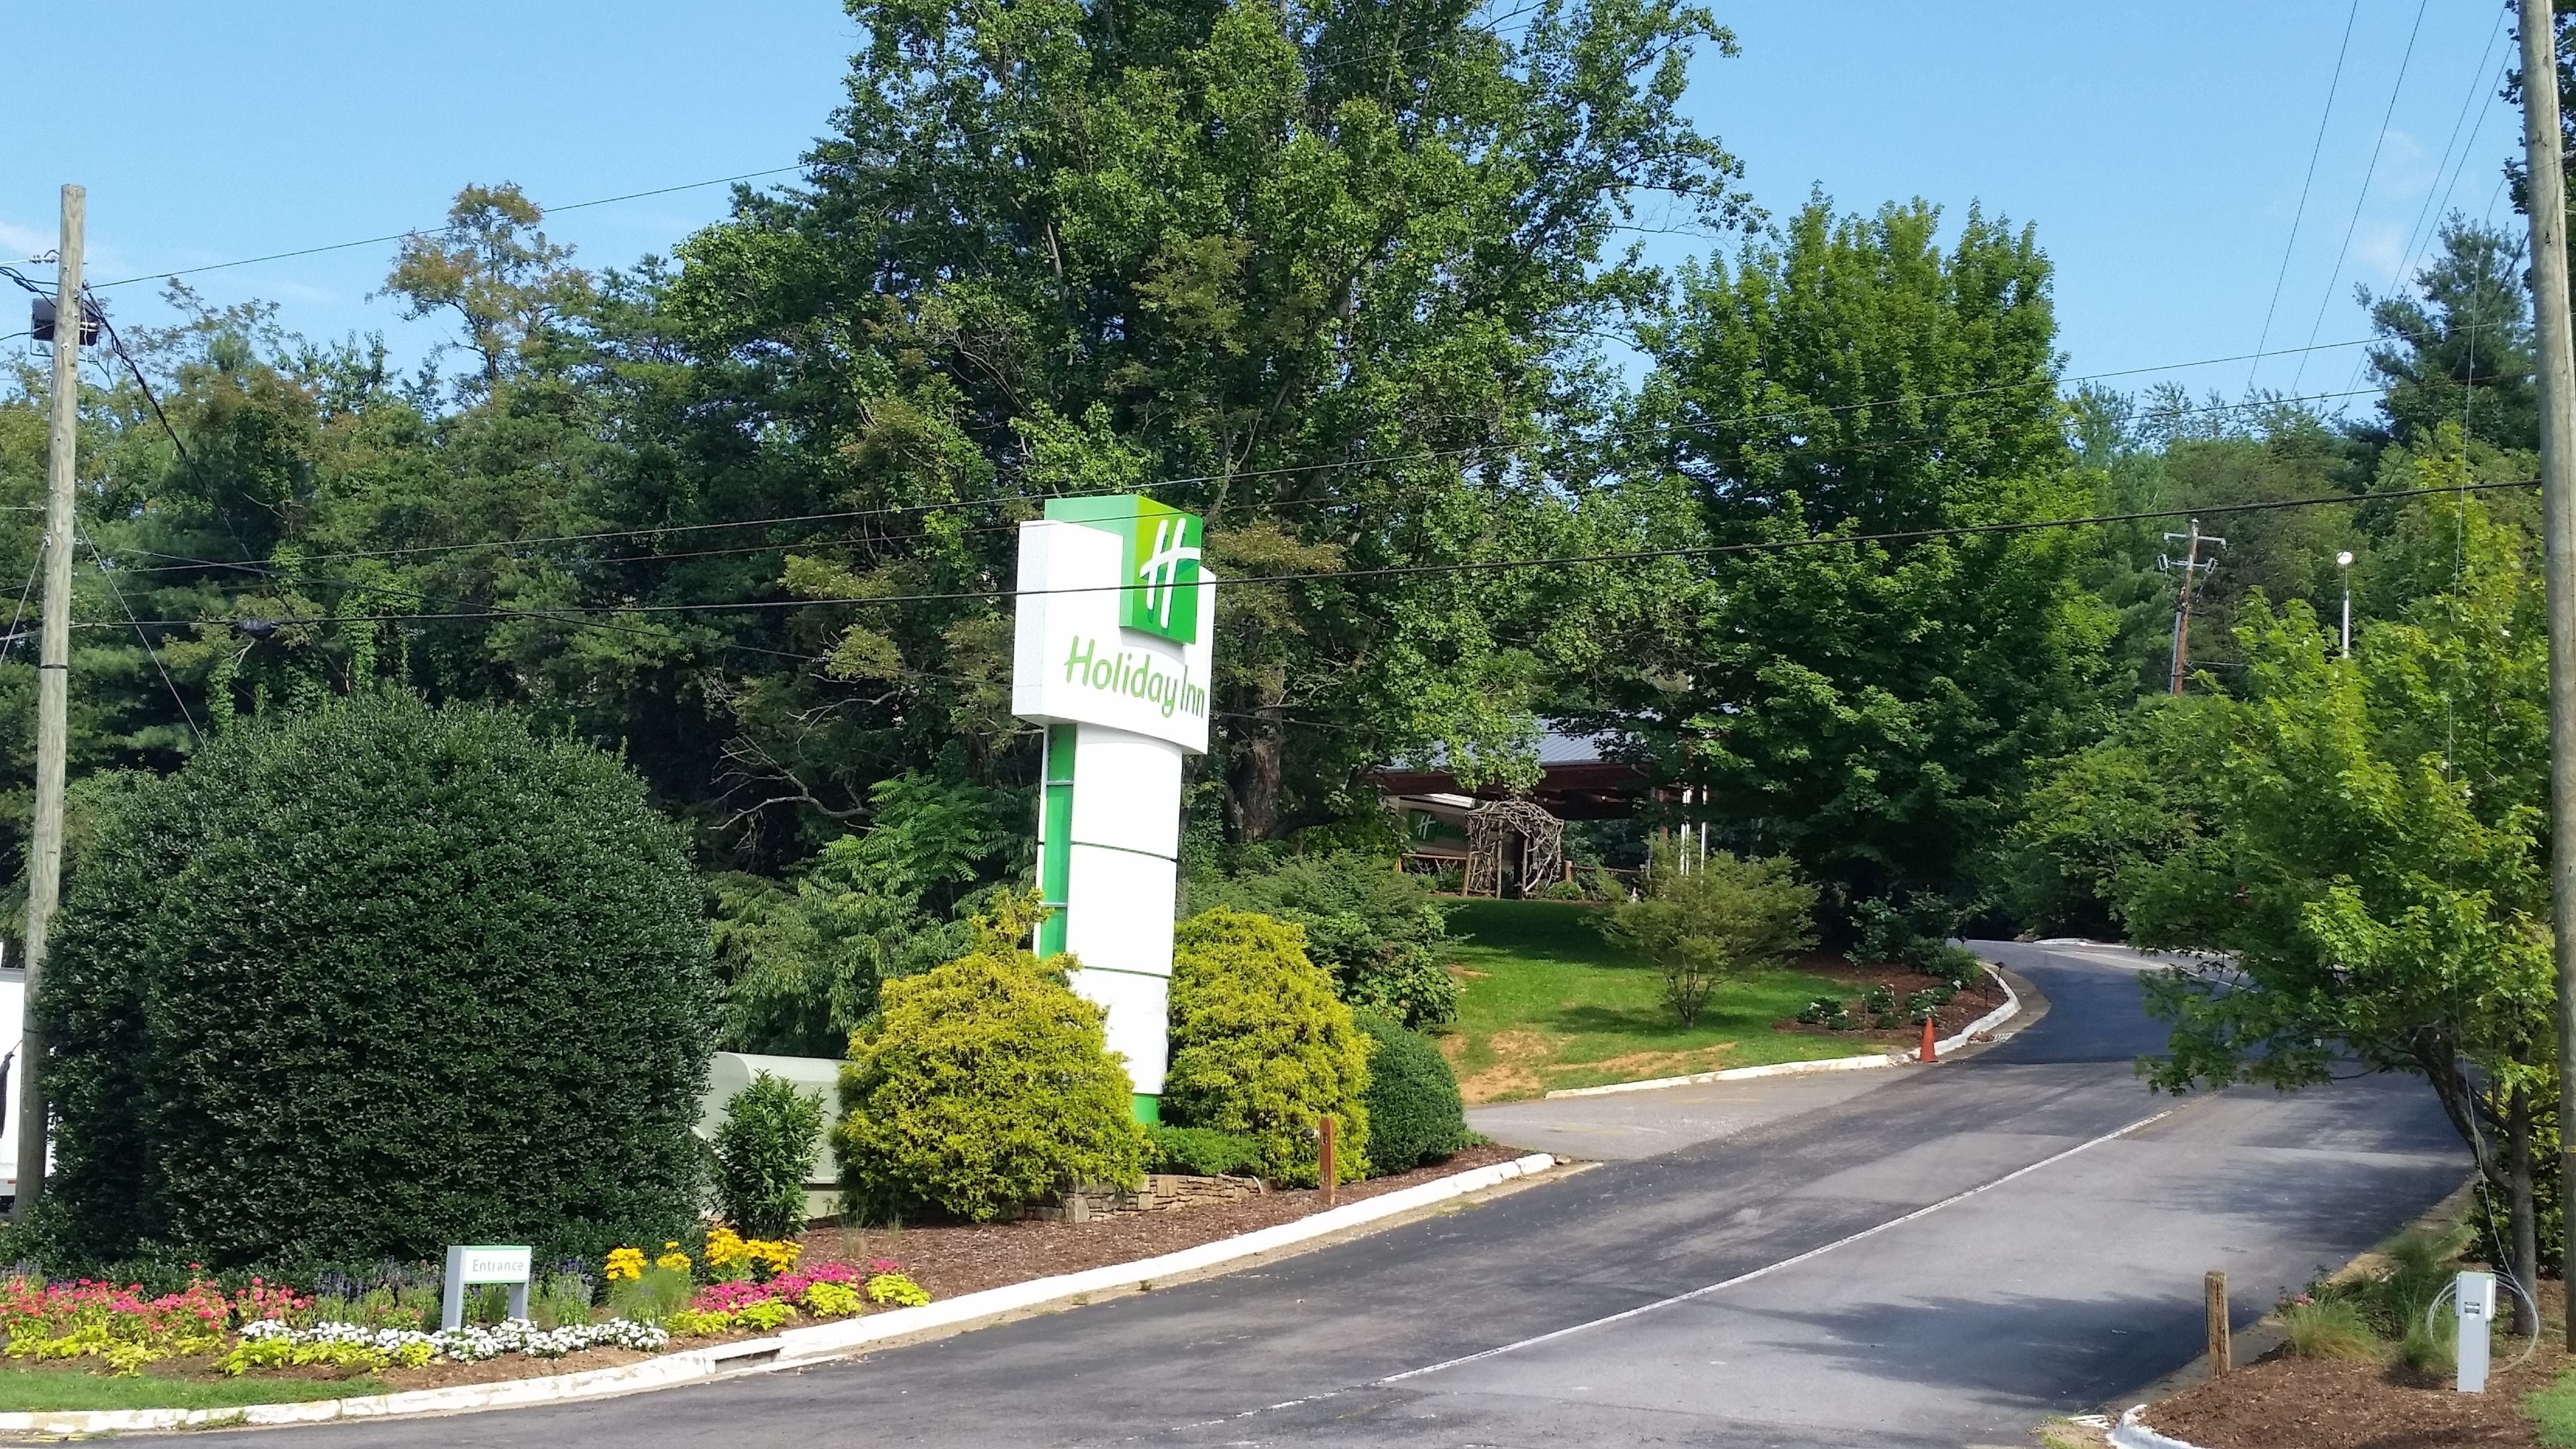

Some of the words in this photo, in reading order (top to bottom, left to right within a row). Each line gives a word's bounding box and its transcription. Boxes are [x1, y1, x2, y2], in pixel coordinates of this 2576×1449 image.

[1064, 635, 1178, 718] Holiday
[1180, 665, 1205, 718] Inn
[472, 1259, 524, 1272] Entrance
